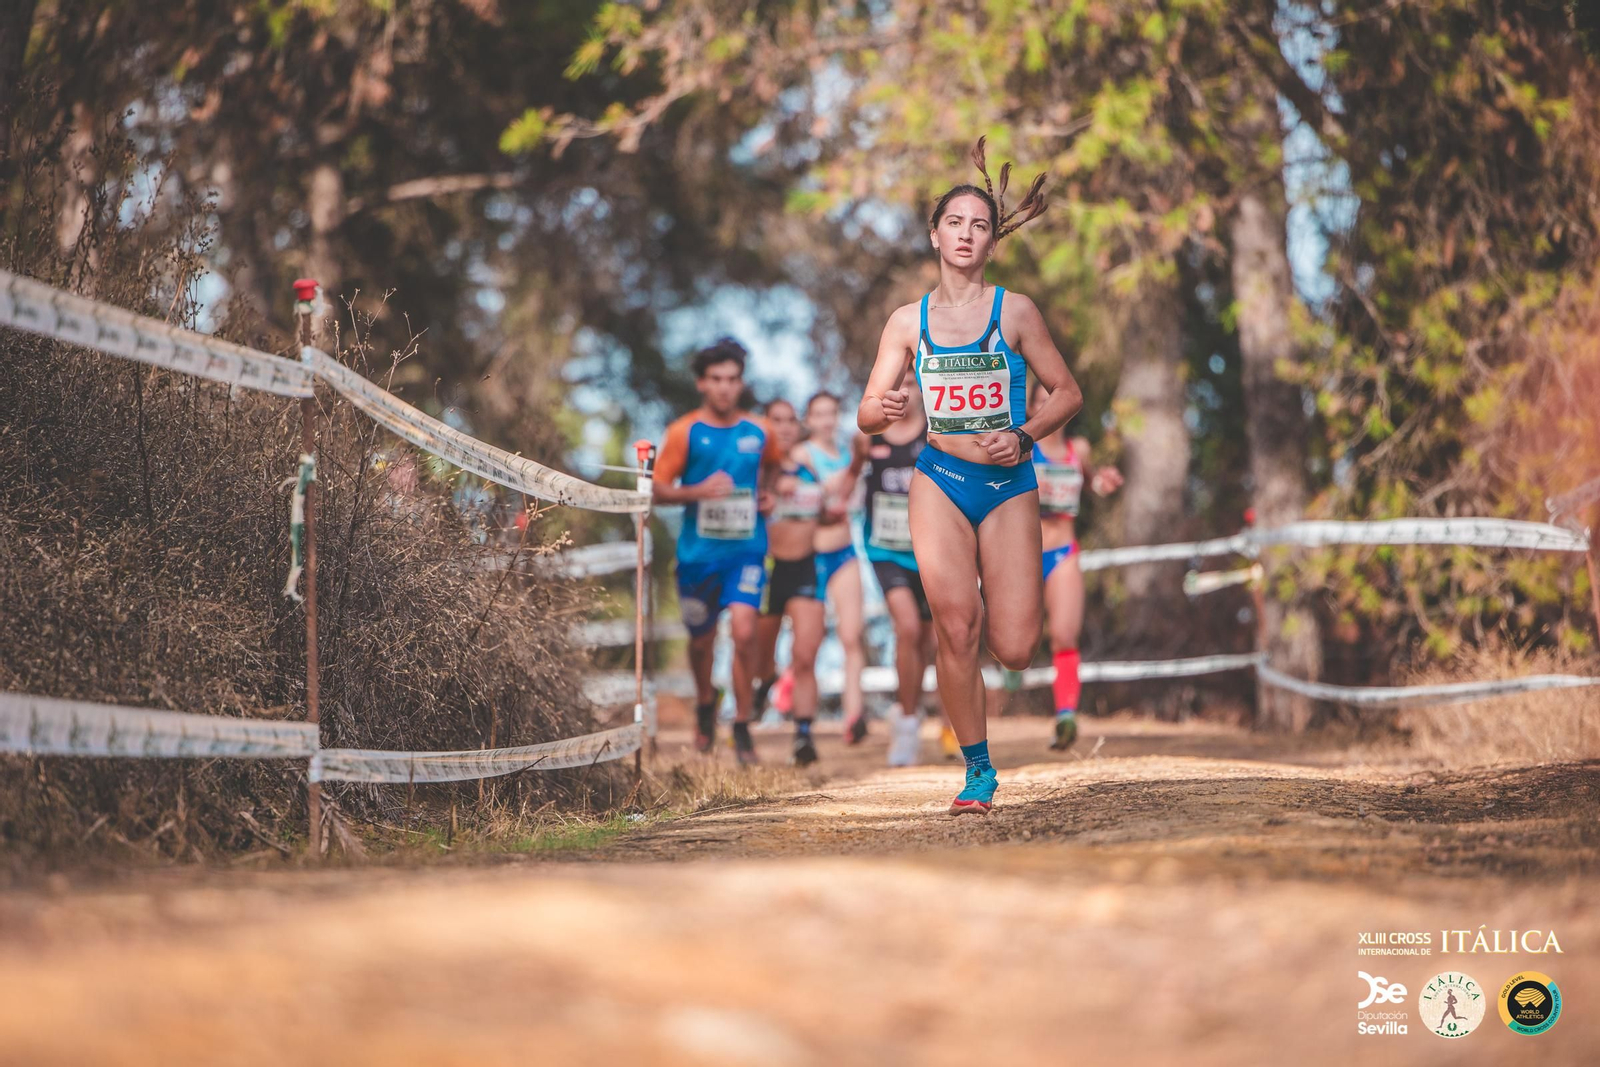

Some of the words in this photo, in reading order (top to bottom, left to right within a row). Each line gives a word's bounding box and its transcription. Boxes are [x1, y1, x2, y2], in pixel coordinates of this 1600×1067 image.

[944, 356, 986, 368] ITÁLICA
[929, 382, 1004, 412] 7563
[932, 463, 965, 483] TROTASIERRA
